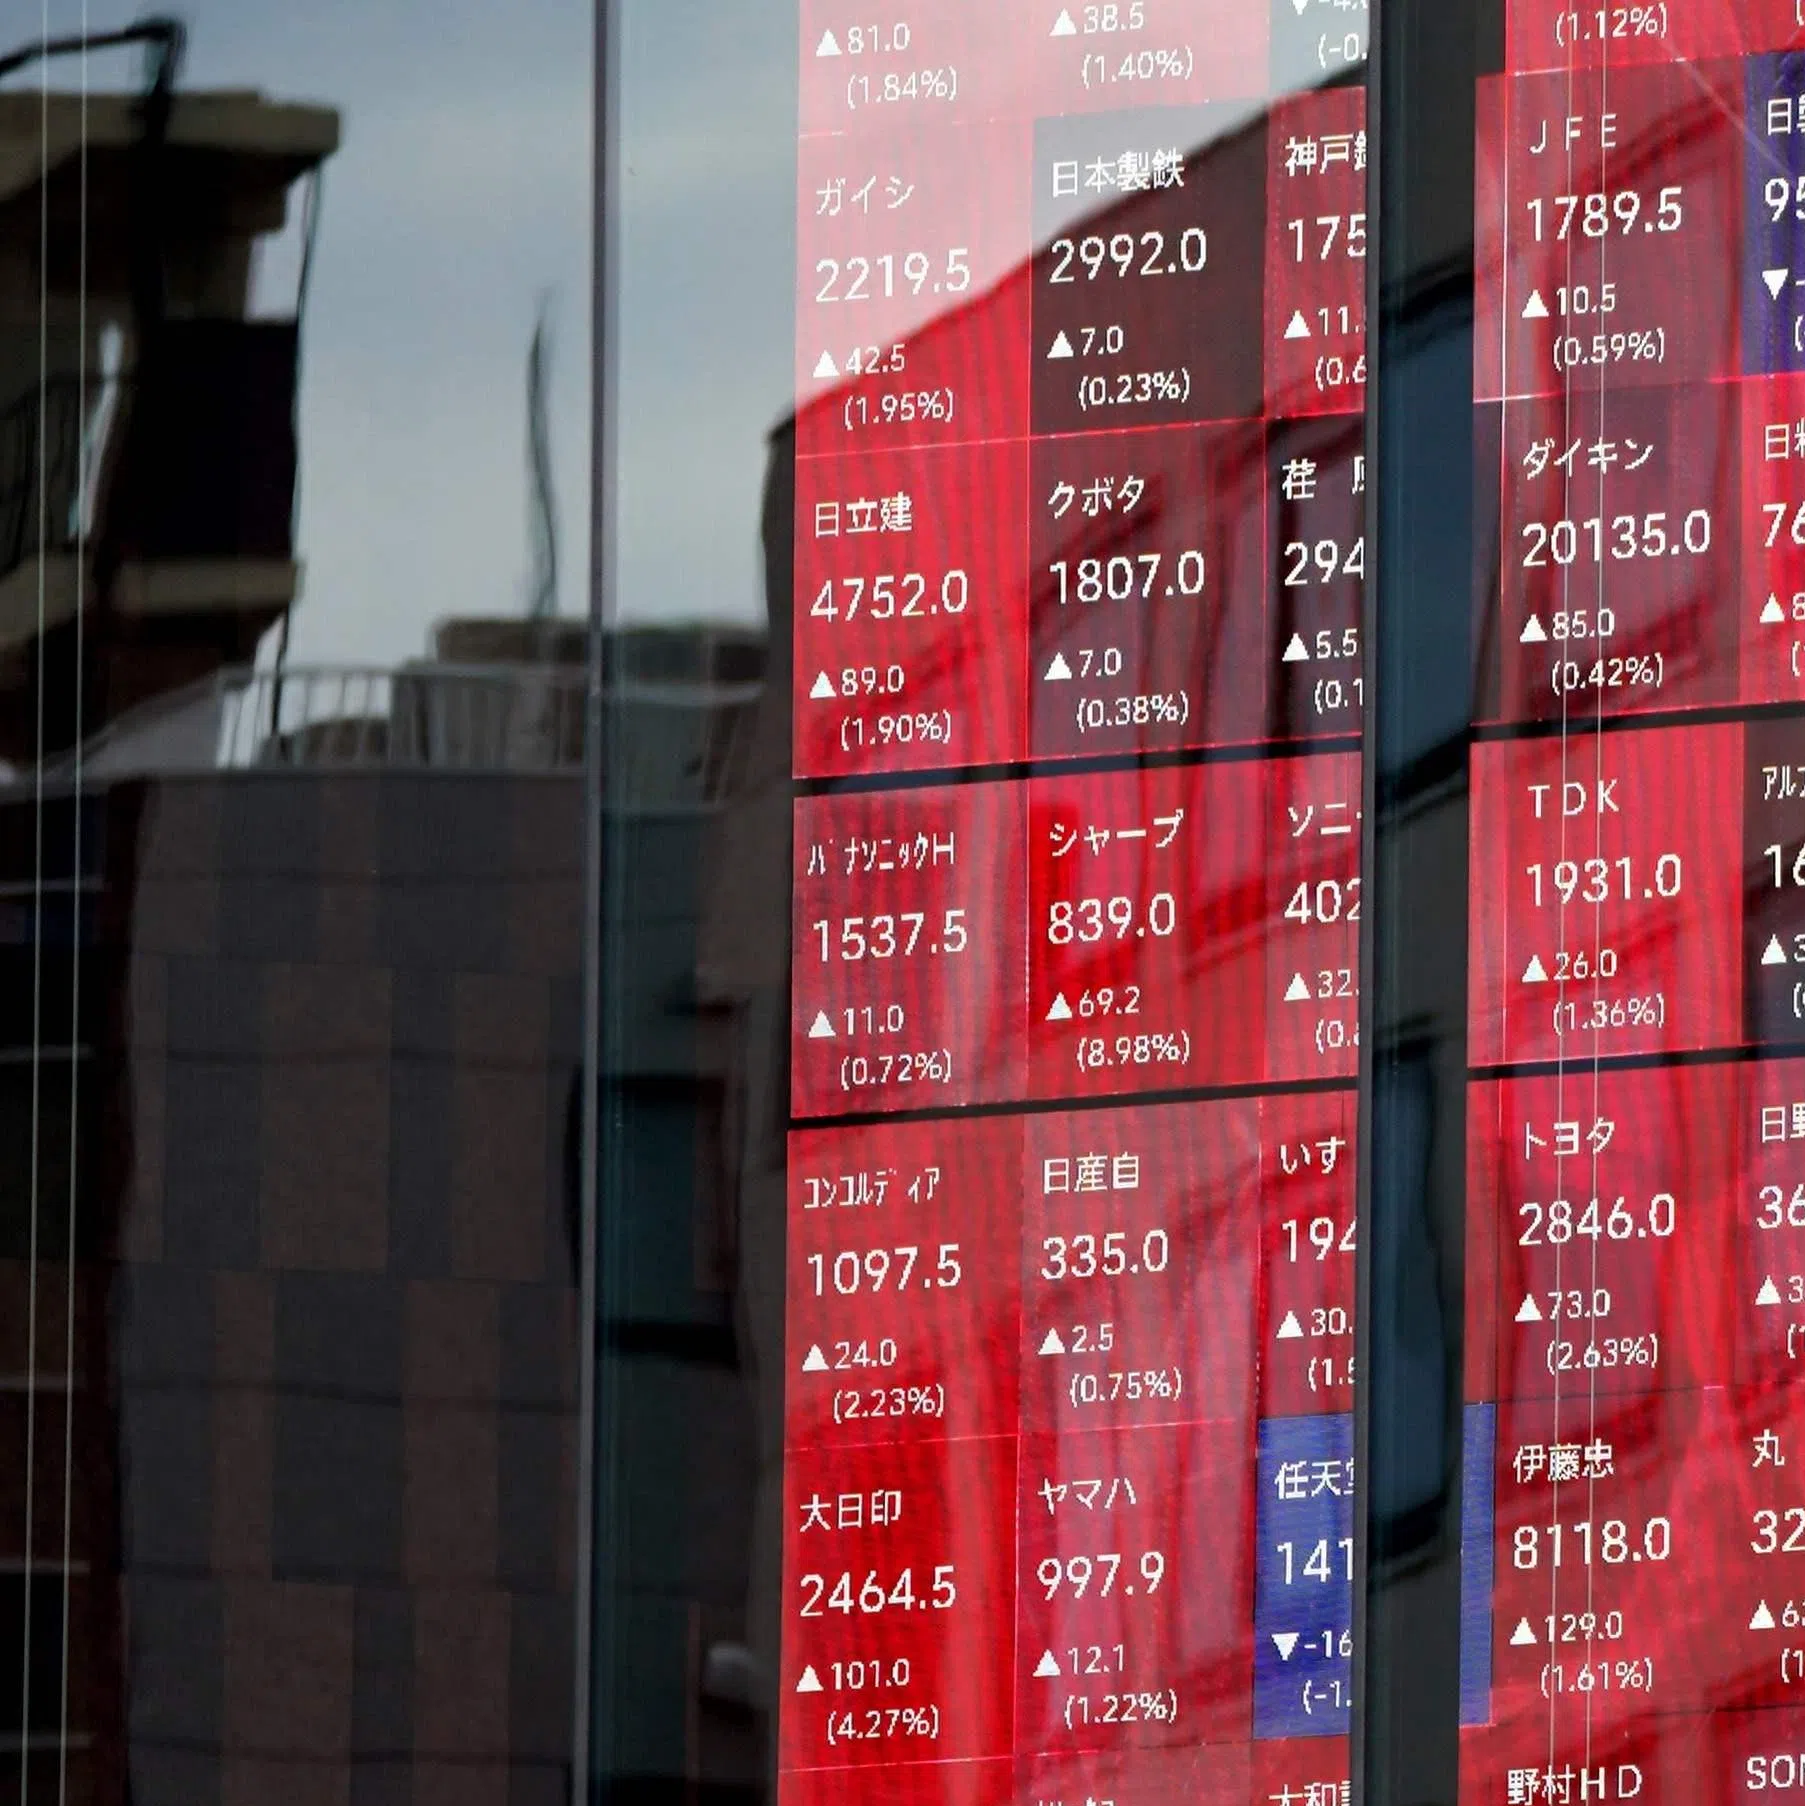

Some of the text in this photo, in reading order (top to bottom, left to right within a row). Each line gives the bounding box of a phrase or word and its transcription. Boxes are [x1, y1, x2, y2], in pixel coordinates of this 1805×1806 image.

[848, 23, 910, 54] 81.0
[1557, 3, 1666, 47] (1.12%)
[1082, 46, 1192, 88] (1.40%)
[1053, 148, 1183, 197] 日本製鉄
[816, 176, 914, 216] ガイシ
[1528, 187, 1681, 241] 1789.5
[816, 248, 969, 302] 2219.5
[1049, 227, 1206, 283] 2992.0
[845, 344, 904, 376] 42.5
[1081, 326, 1123, 355] 7.0
[1524, 436, 1653, 480] ダイキン
[816, 492, 911, 537] 日立建
[1048, 476, 1144, 519] クボタ
[1523, 510, 1710, 569] 20135.0
[1050, 551, 1204, 603] 1807.0
[1050, 809, 1183, 856] シャープ
[1527, 854, 1680, 906] 1931.0
[1049, 893, 1174, 943] 839.0
[1080, 986, 1139, 1016] 69.2
[842, 1048, 951, 1090] (0.72%)
[1526, 1118, 1614, 1159] トヨタ
[1044, 1152, 1138, 1193] 日産自
[808, 1244, 960, 1295] 1097.5
[1042, 1230, 1167, 1279] 335.0
[1548, 1289, 1610, 1319] 73.0
[835, 1339, 896, 1369] 24.0
[1513, 1439, 1613, 1482] 伊藤忠
[800, 1490, 901, 1532] 大日印
[1039, 1478, 1136, 1514] ヤマハ
[1038, 1552, 1163, 1600] 997.9
[831, 1659, 909, 1690] 101.0
[1065, 1689, 1176, 1729] (1.22%)
